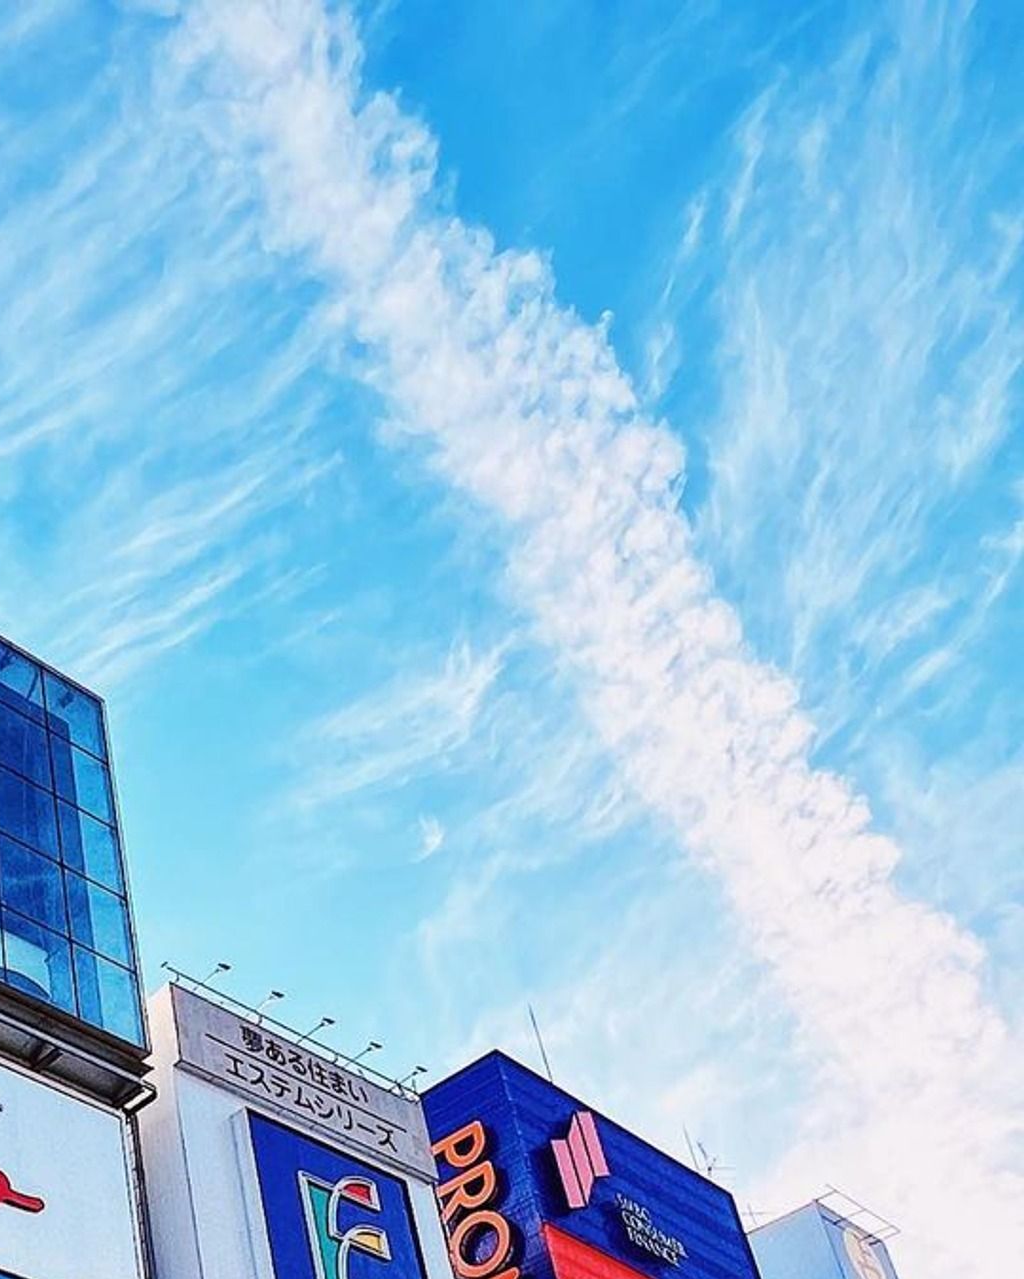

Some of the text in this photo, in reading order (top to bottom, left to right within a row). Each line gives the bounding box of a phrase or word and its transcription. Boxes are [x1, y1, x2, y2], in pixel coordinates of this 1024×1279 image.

[225, 1053, 397, 1153] エステムシリーズ
[239, 1024, 370, 1104] 夢ある住まい
